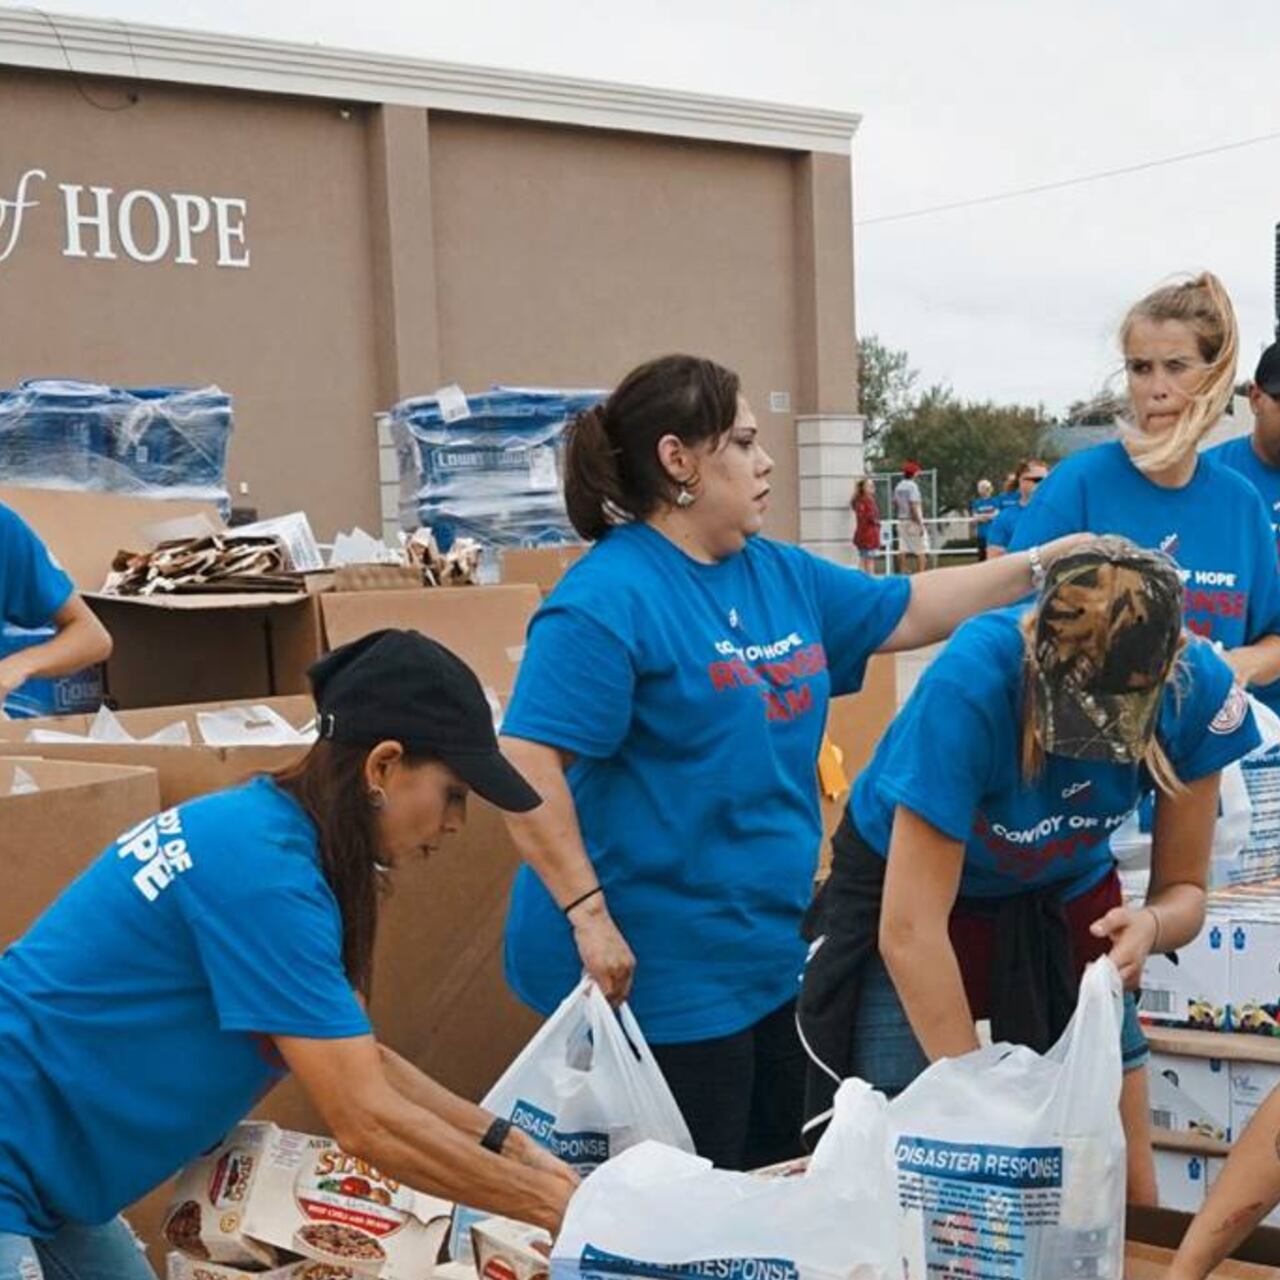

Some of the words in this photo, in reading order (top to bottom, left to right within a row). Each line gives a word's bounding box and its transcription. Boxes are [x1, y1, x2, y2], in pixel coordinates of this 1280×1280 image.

[57, 183, 251, 267] HOPE
[1195, 571, 1237, 586] HOPE
[512, 1108, 553, 1141] DISAST
[550, 1139, 607, 1157] SPONSE
[895, 1144, 980, 1172] DISASTER
[985, 1154, 1061, 1177] RESPONSE
